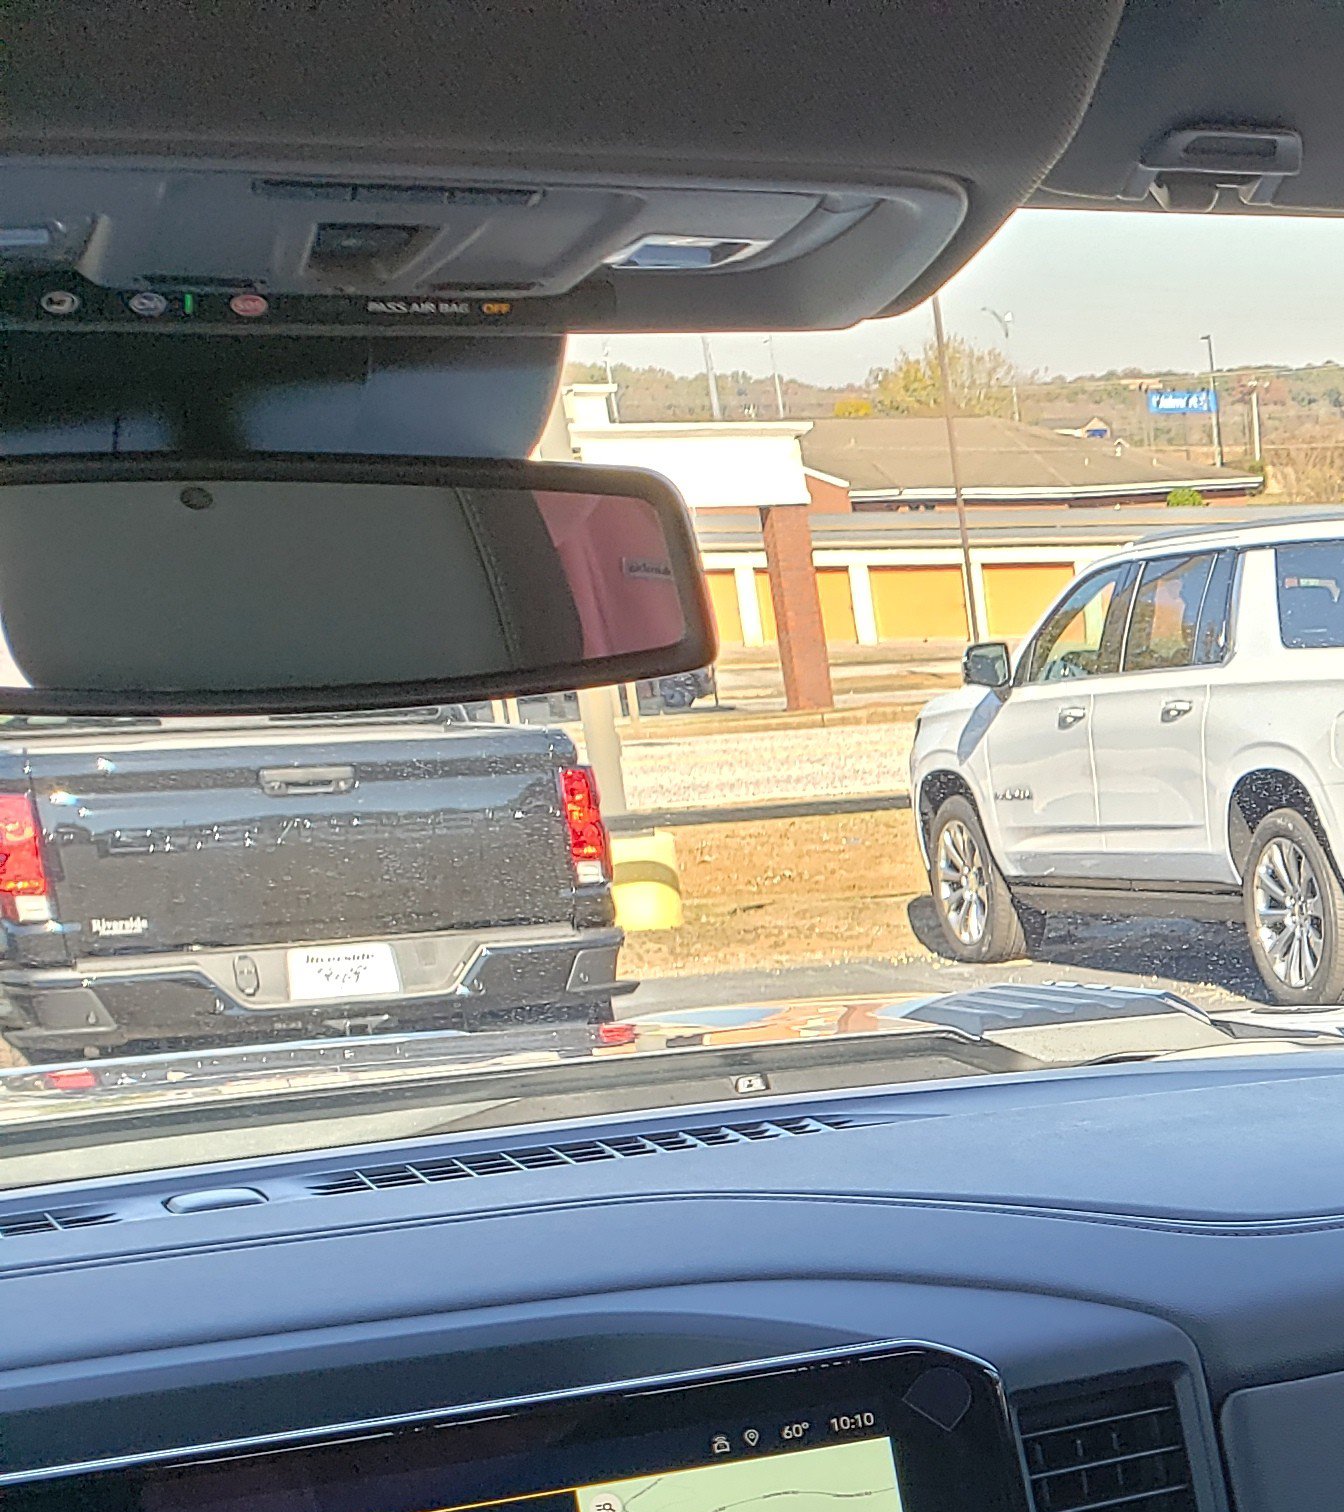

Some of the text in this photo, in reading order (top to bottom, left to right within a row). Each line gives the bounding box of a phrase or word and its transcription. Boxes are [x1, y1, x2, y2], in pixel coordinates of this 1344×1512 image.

[439, 302, 469, 313] BAG
[482, 303, 510, 314] OFF
[781, 1412, 875, 1439] 60° 10:10
